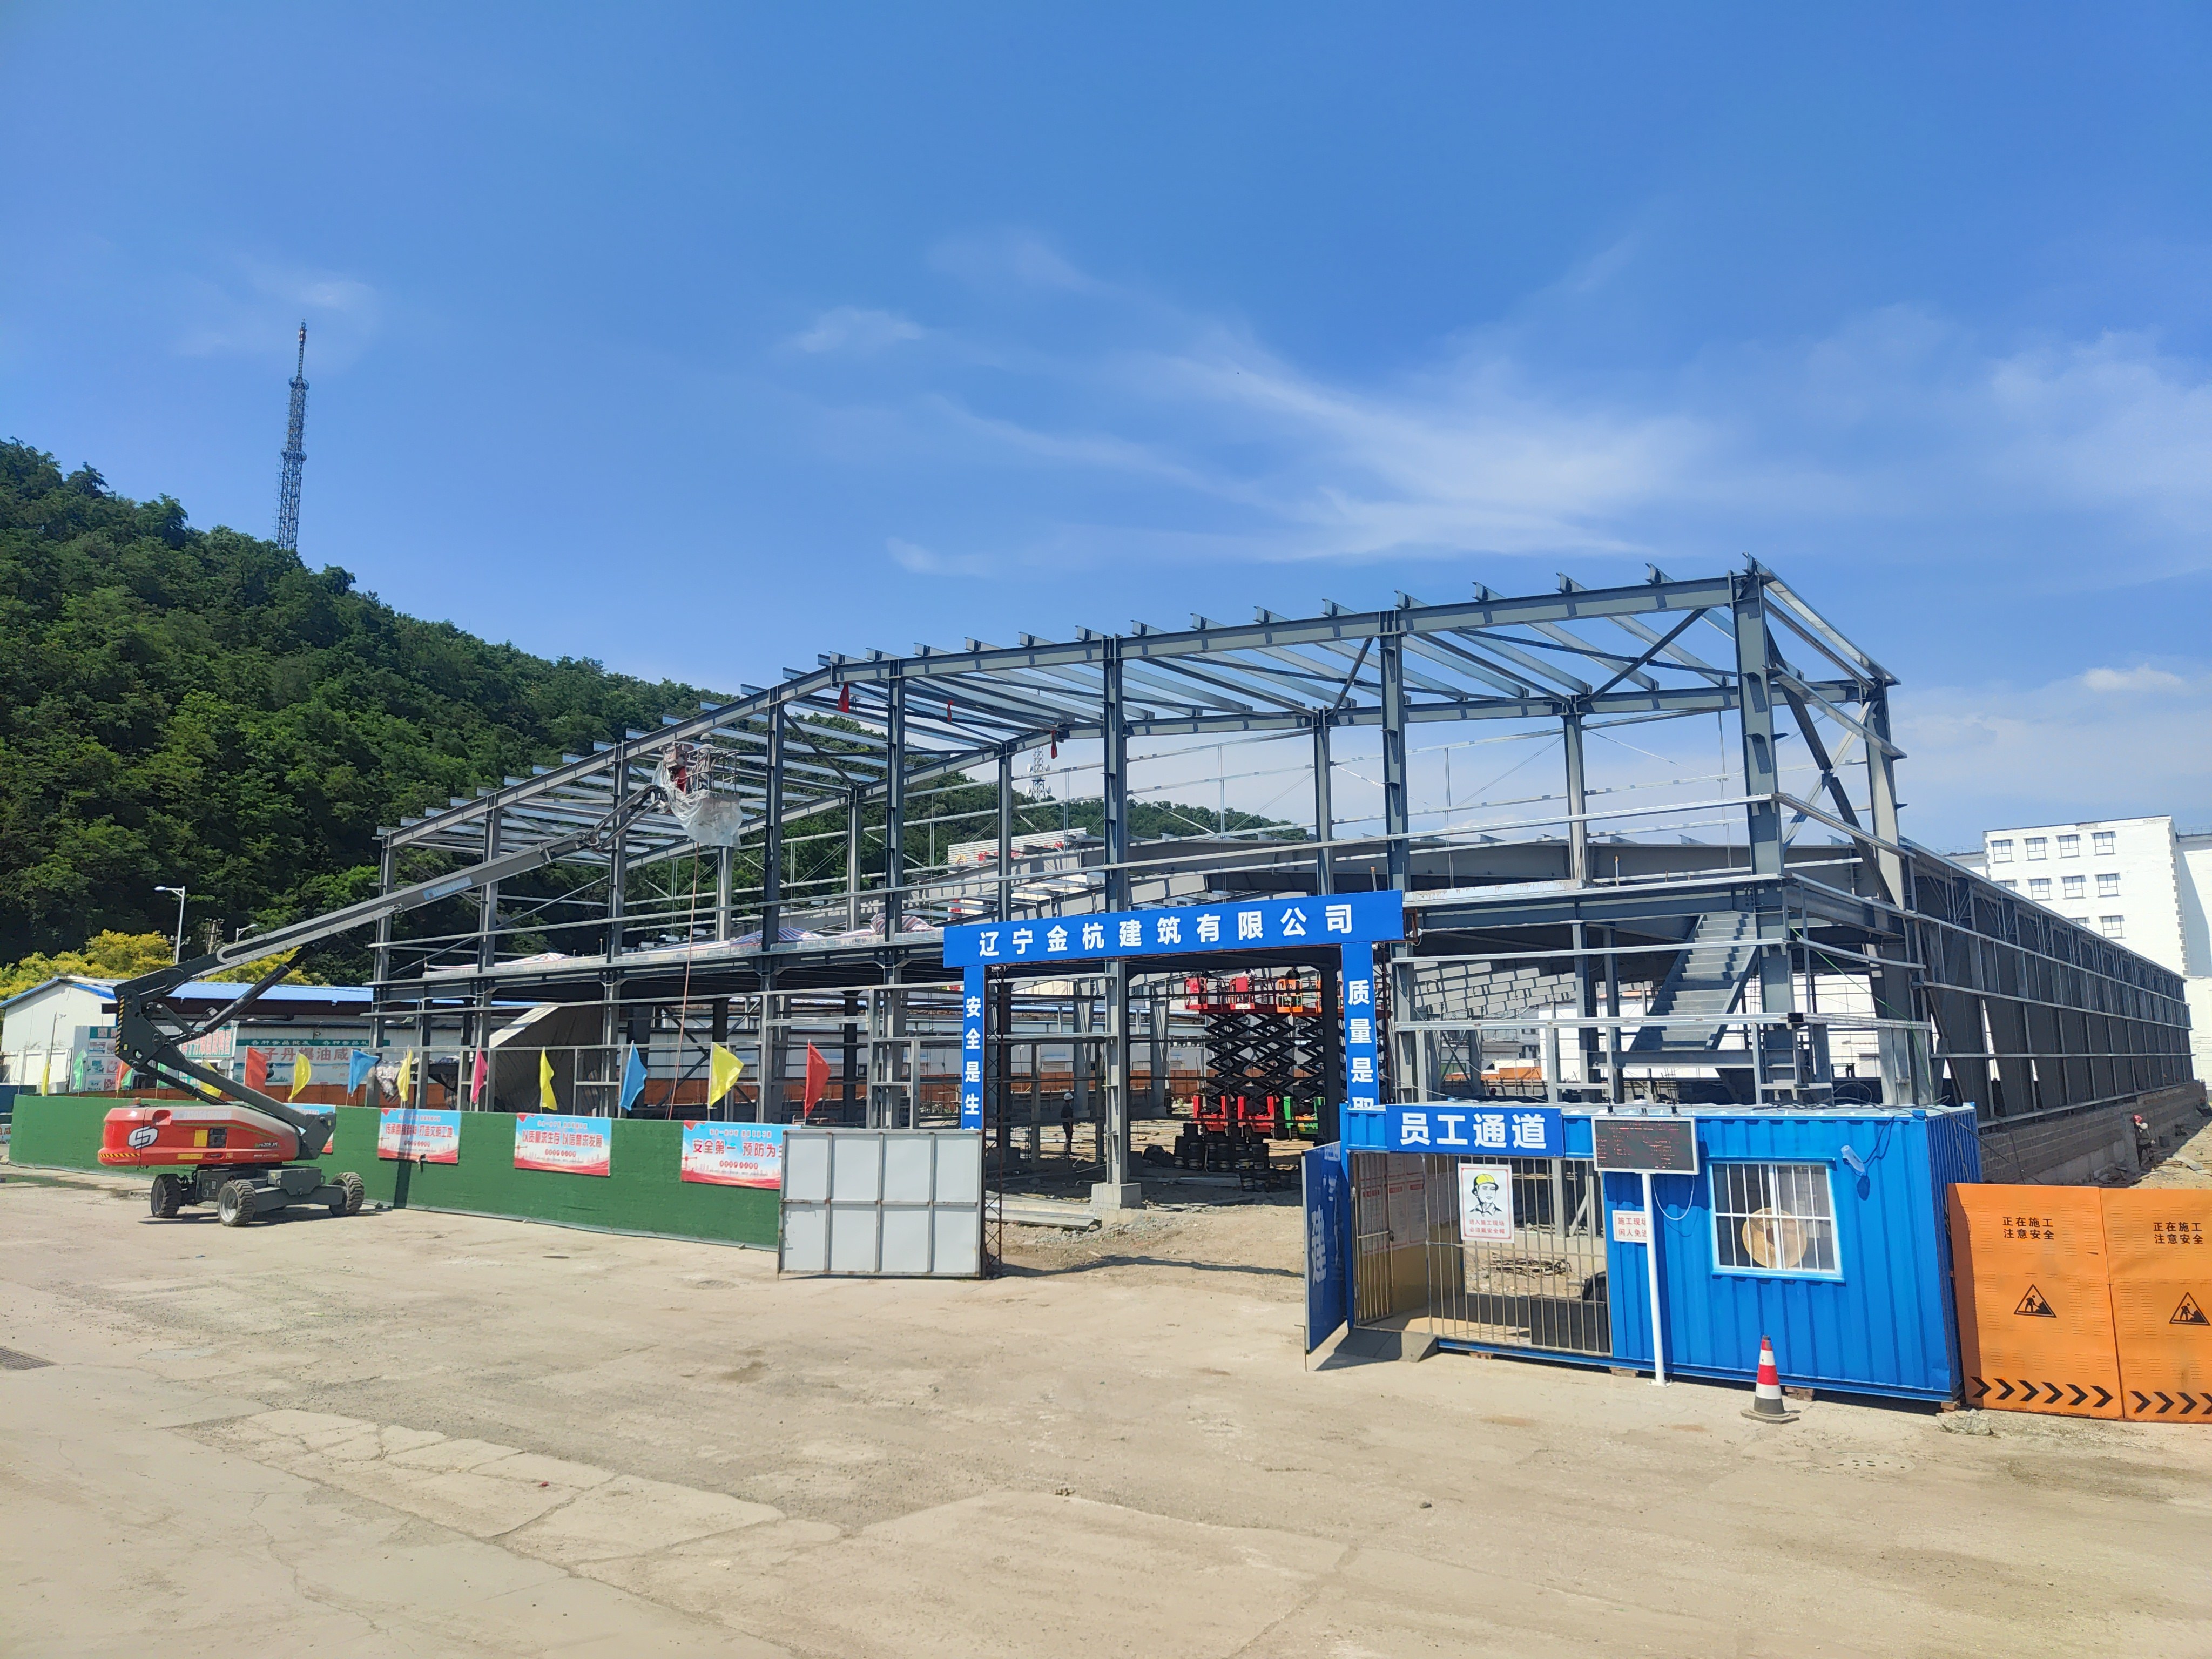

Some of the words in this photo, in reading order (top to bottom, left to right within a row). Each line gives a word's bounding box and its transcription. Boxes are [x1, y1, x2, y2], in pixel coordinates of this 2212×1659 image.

[979, 903, 1352, 957] 辽宁金杭建筑有限公司
[965, 996, 981, 1130] 安全是生
[1400, 1112, 1547, 1149] 员工通道
[522, 1130, 560, 1144] 以质量求生存
[562, 1132, 603, 1148] 以信誉求发展
[693, 1139, 736, 1154] 安全第一
[2002, 1217, 2054, 1228] 正在施工
[2153, 1222, 2203, 1232] 正在施工
[2004, 1228, 2054, 1240] 注意安全
[2154, 1233, 2203, 1245] 注意安全
